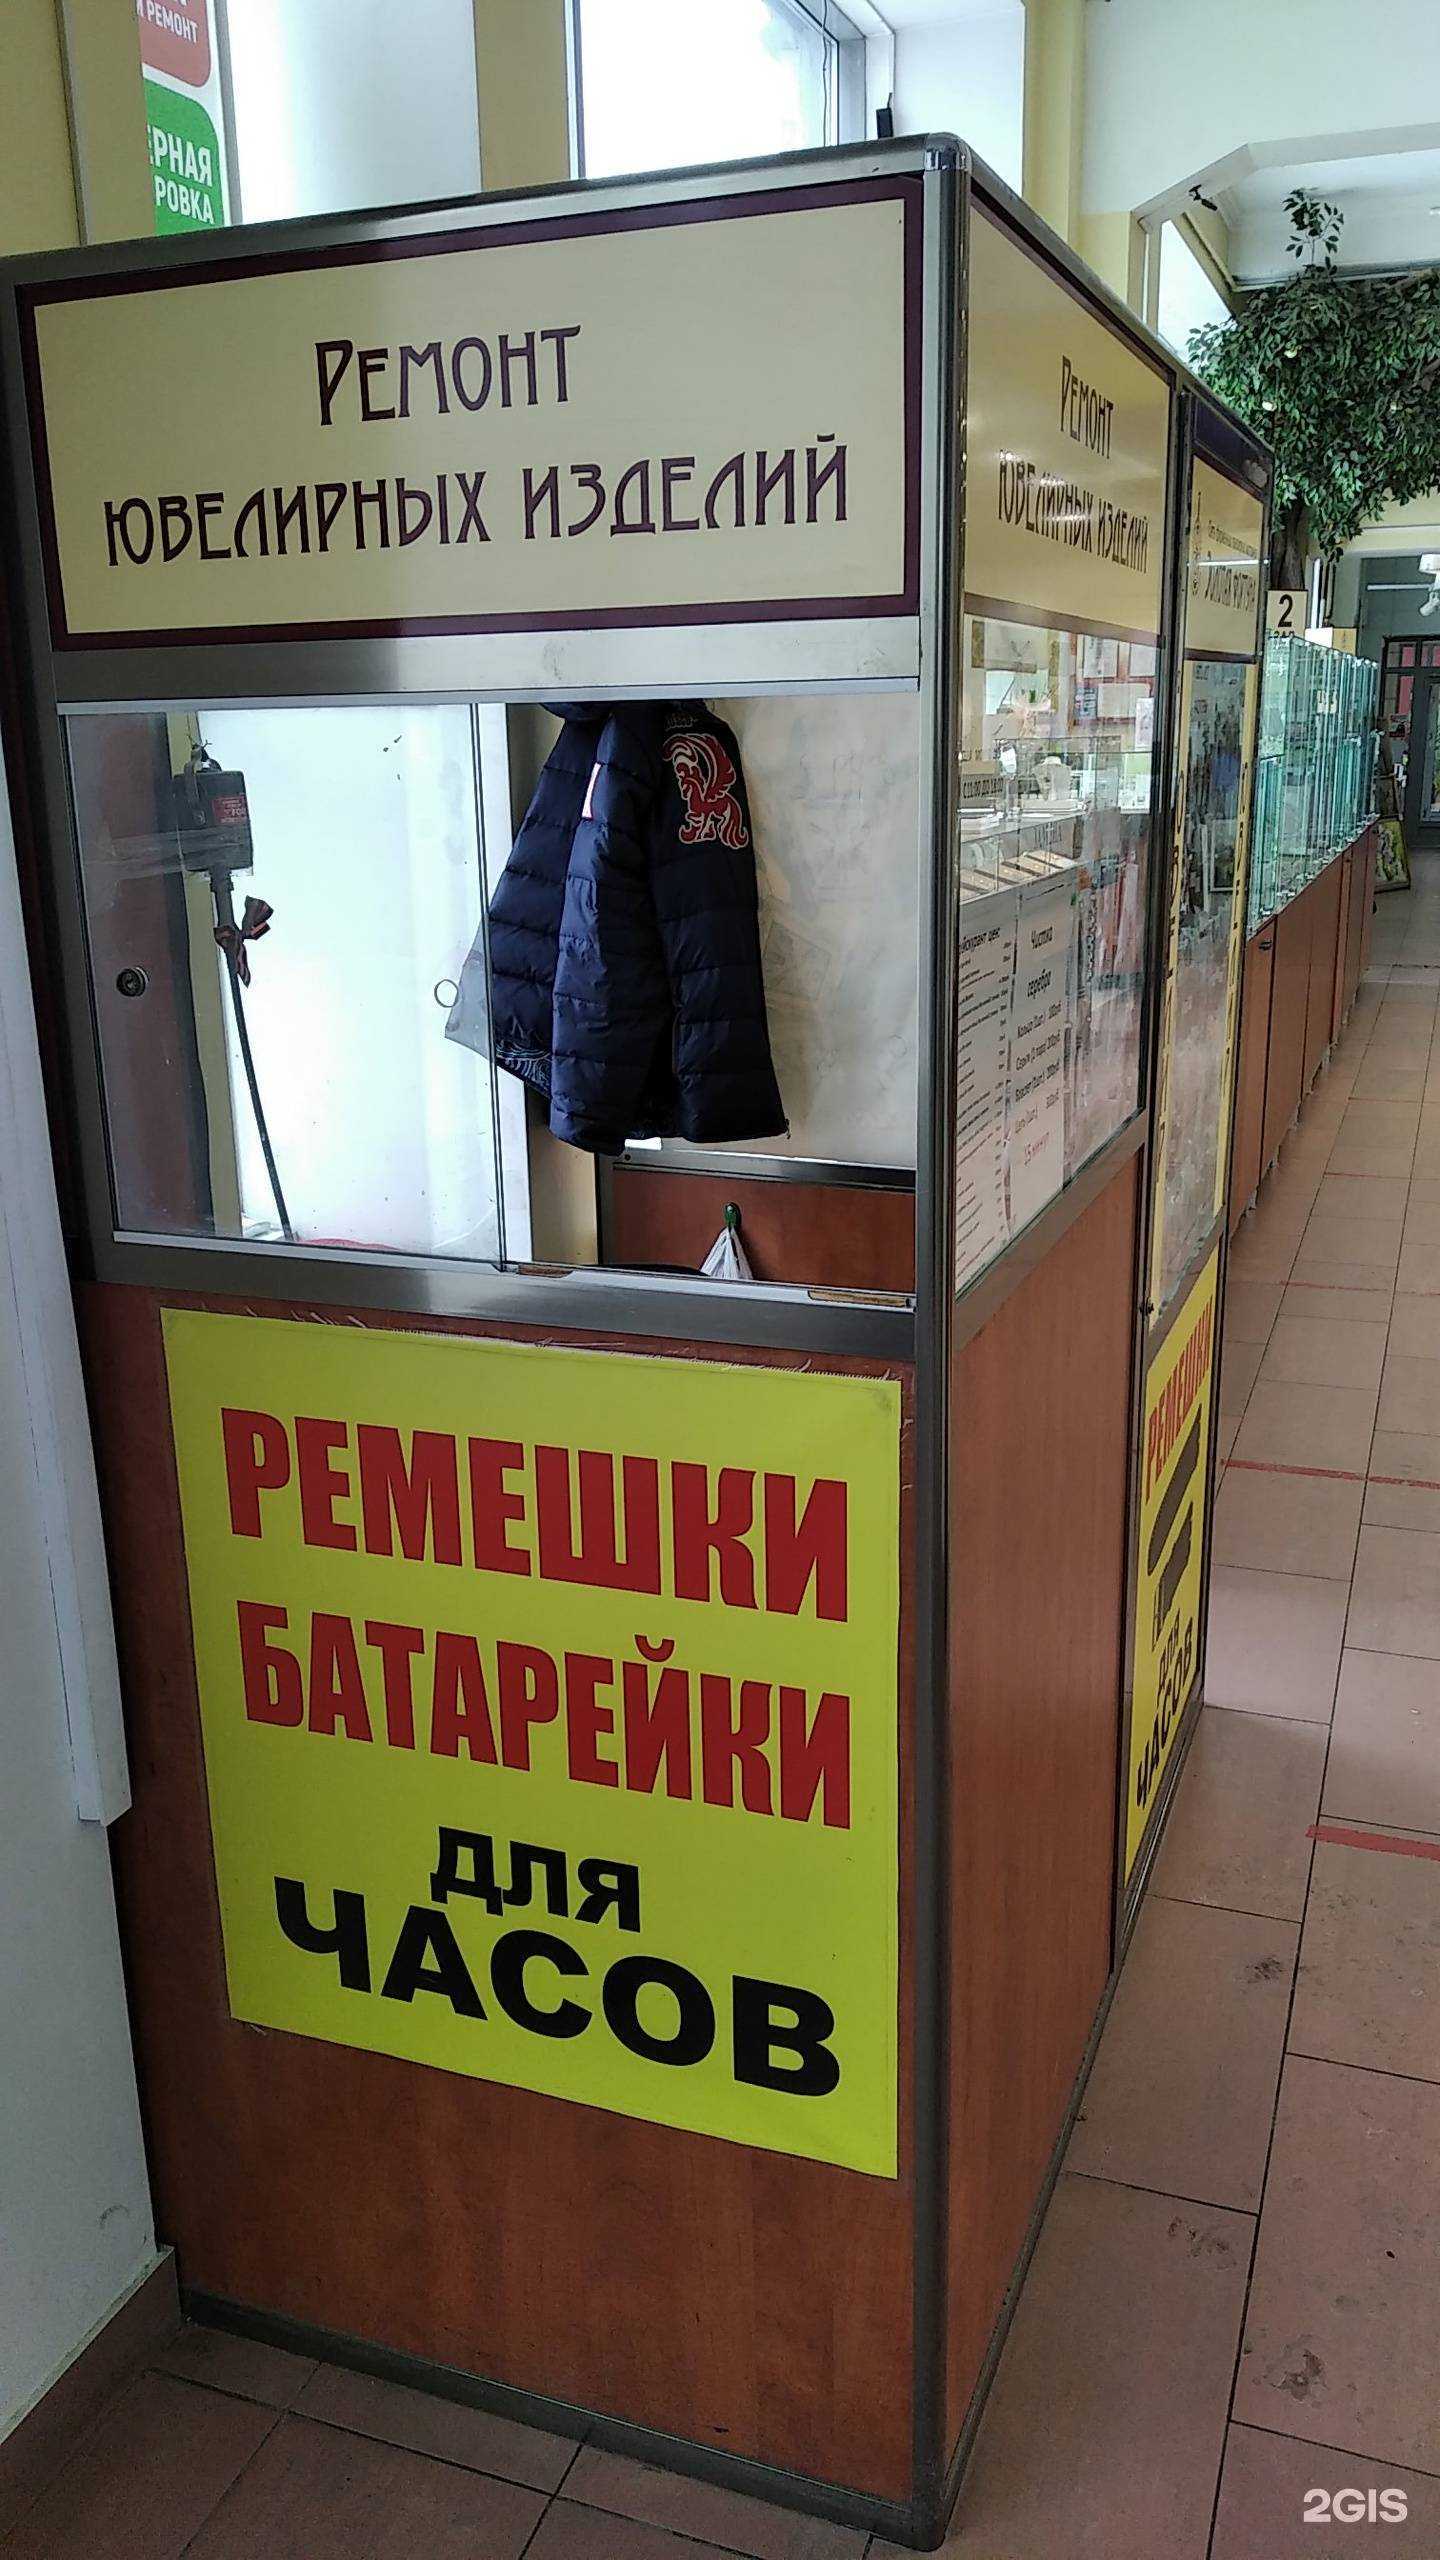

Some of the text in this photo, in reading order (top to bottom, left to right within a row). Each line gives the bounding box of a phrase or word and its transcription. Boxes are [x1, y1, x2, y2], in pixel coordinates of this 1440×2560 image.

[147, 2, 199, 43] РЕМОНТ
[154, 174, 215, 225] РОВКА
[315, 325, 581, 426] РЕМОНТ
[1060, 355, 1114, 459] РЕМОНТ
[103, 433, 847, 567] ЮВЕЛИРНЫХ ИЗДЕЛИЙ
[998, 450, 1094, 554] ЮВЕЛИРНЫХ
[1097, 497, 1149, 574] ИЗДЕЛИЙ
[1278, 594, 1294, 628] 2
[1146, 1294, 1213, 1505] РЕМЕШКИ
[221, 1407, 848, 1622] РЕМЕШКИ
[236, 1600, 851, 1830] БАТАРЕЙКИ
[1136, 1616, 1193, 1811] ЧАСОВ
[431, 1825, 642, 1933] ДЛЯ
[274, 1876, 841, 2097] ЧАСОВ
